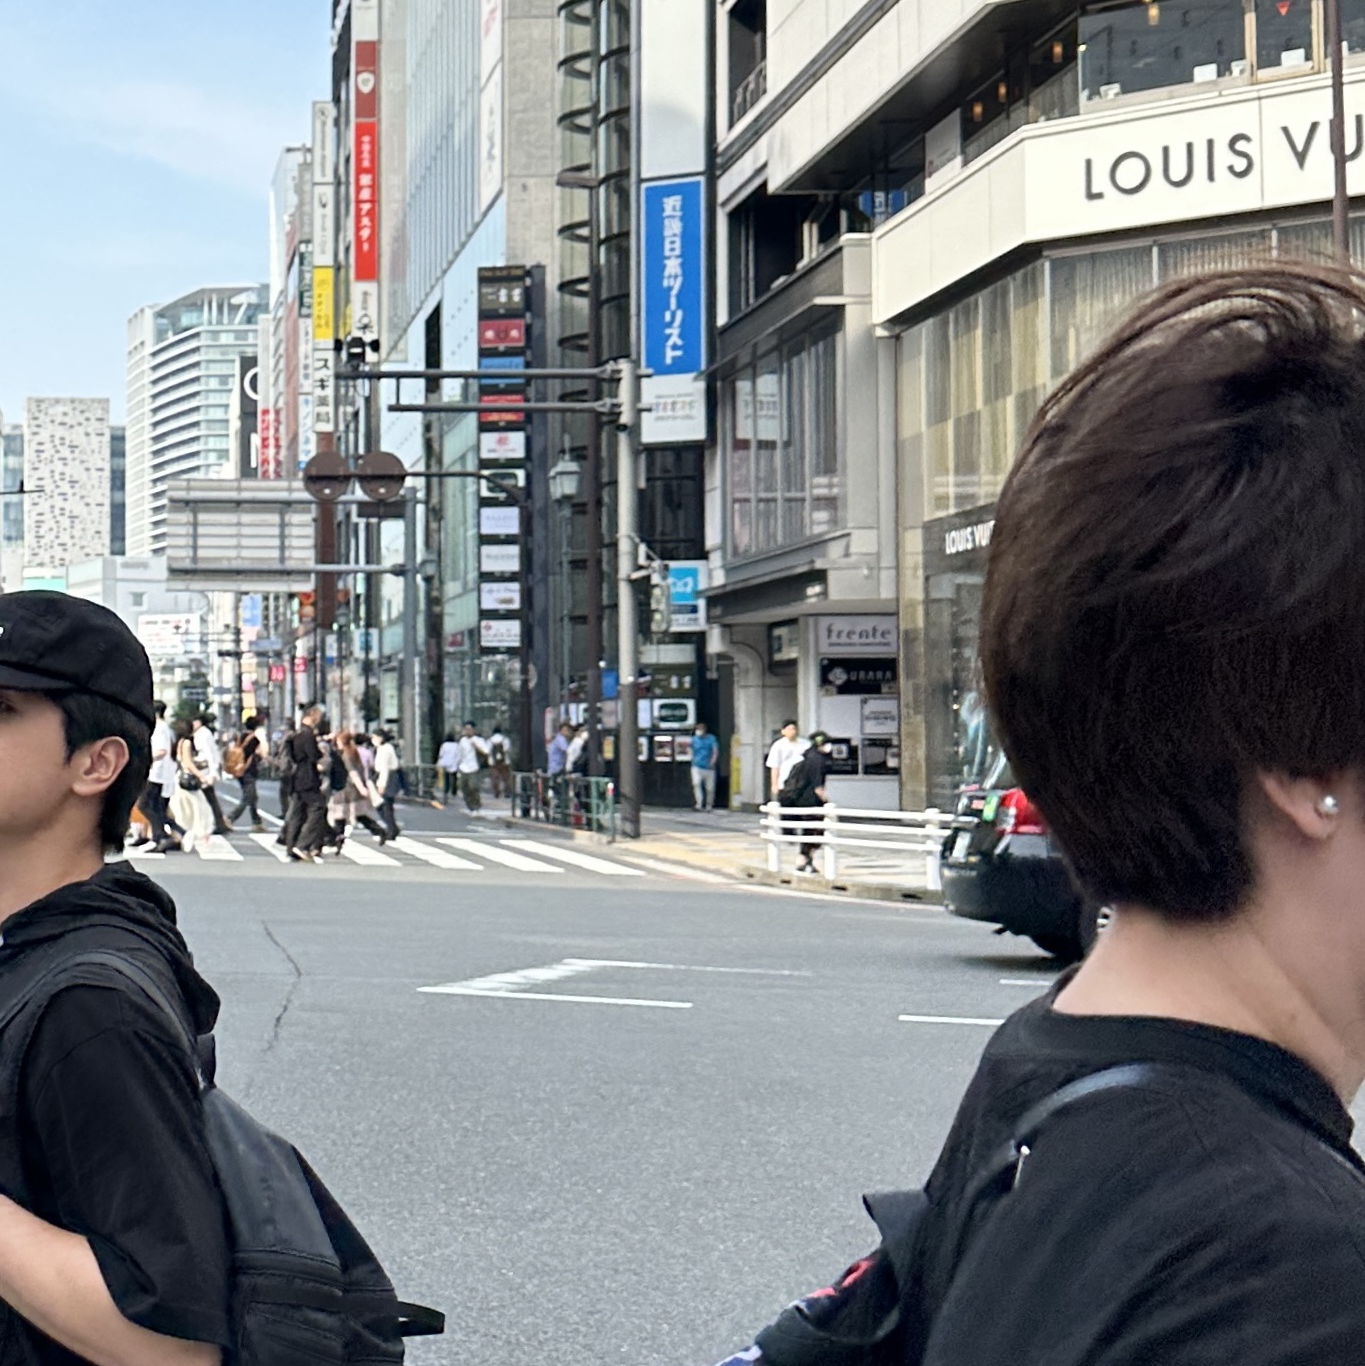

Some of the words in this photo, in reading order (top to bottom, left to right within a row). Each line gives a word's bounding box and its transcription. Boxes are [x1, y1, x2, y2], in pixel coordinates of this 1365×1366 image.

[1084, 132, 1254, 201] LOUIS
[662, 194, 684, 366] 近畿日本ツーリスト
[945, 526, 973, 555] LOUIS
[826, 622, 892, 640] frente
